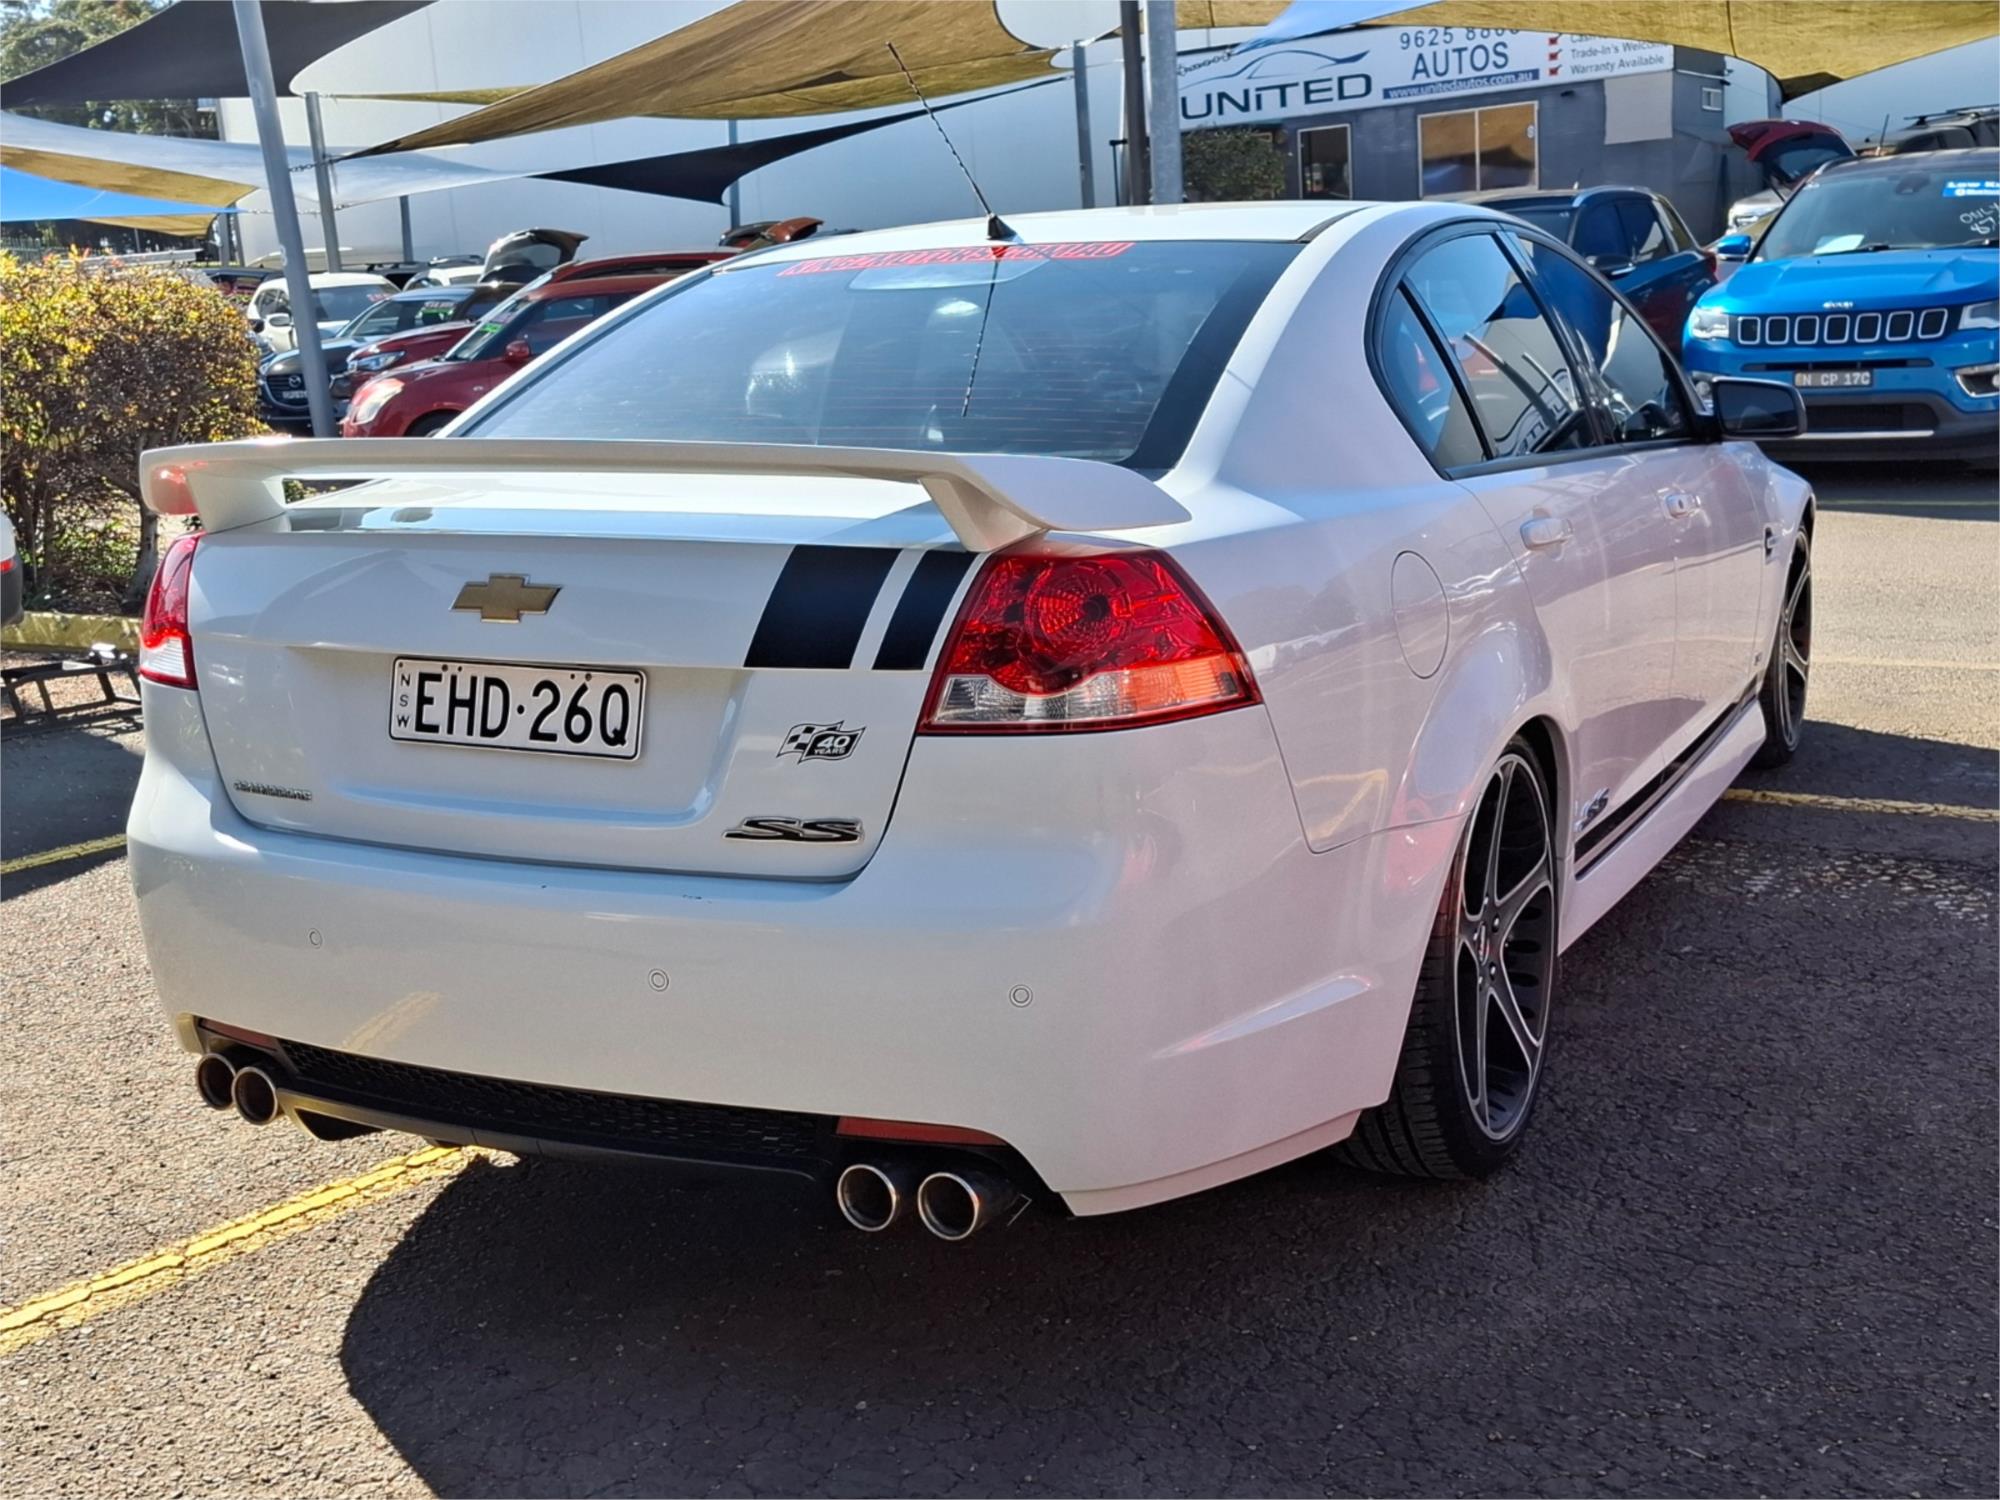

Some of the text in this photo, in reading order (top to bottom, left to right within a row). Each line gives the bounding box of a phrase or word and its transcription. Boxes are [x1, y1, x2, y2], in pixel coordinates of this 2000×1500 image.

[1400, 27, 1454, 50] 9625
[1411, 41, 1509, 80] AUTOS
[1570, 54, 1664, 75] Warranty Available
[1181, 73, 1372, 120] UNITED
[1388, 72, 1533, 98] www.unitedautos.com.au
[813, 747, 847, 756] YEARS
[816, 735, 851, 749] 40
[721, 815, 866, 846] SS
